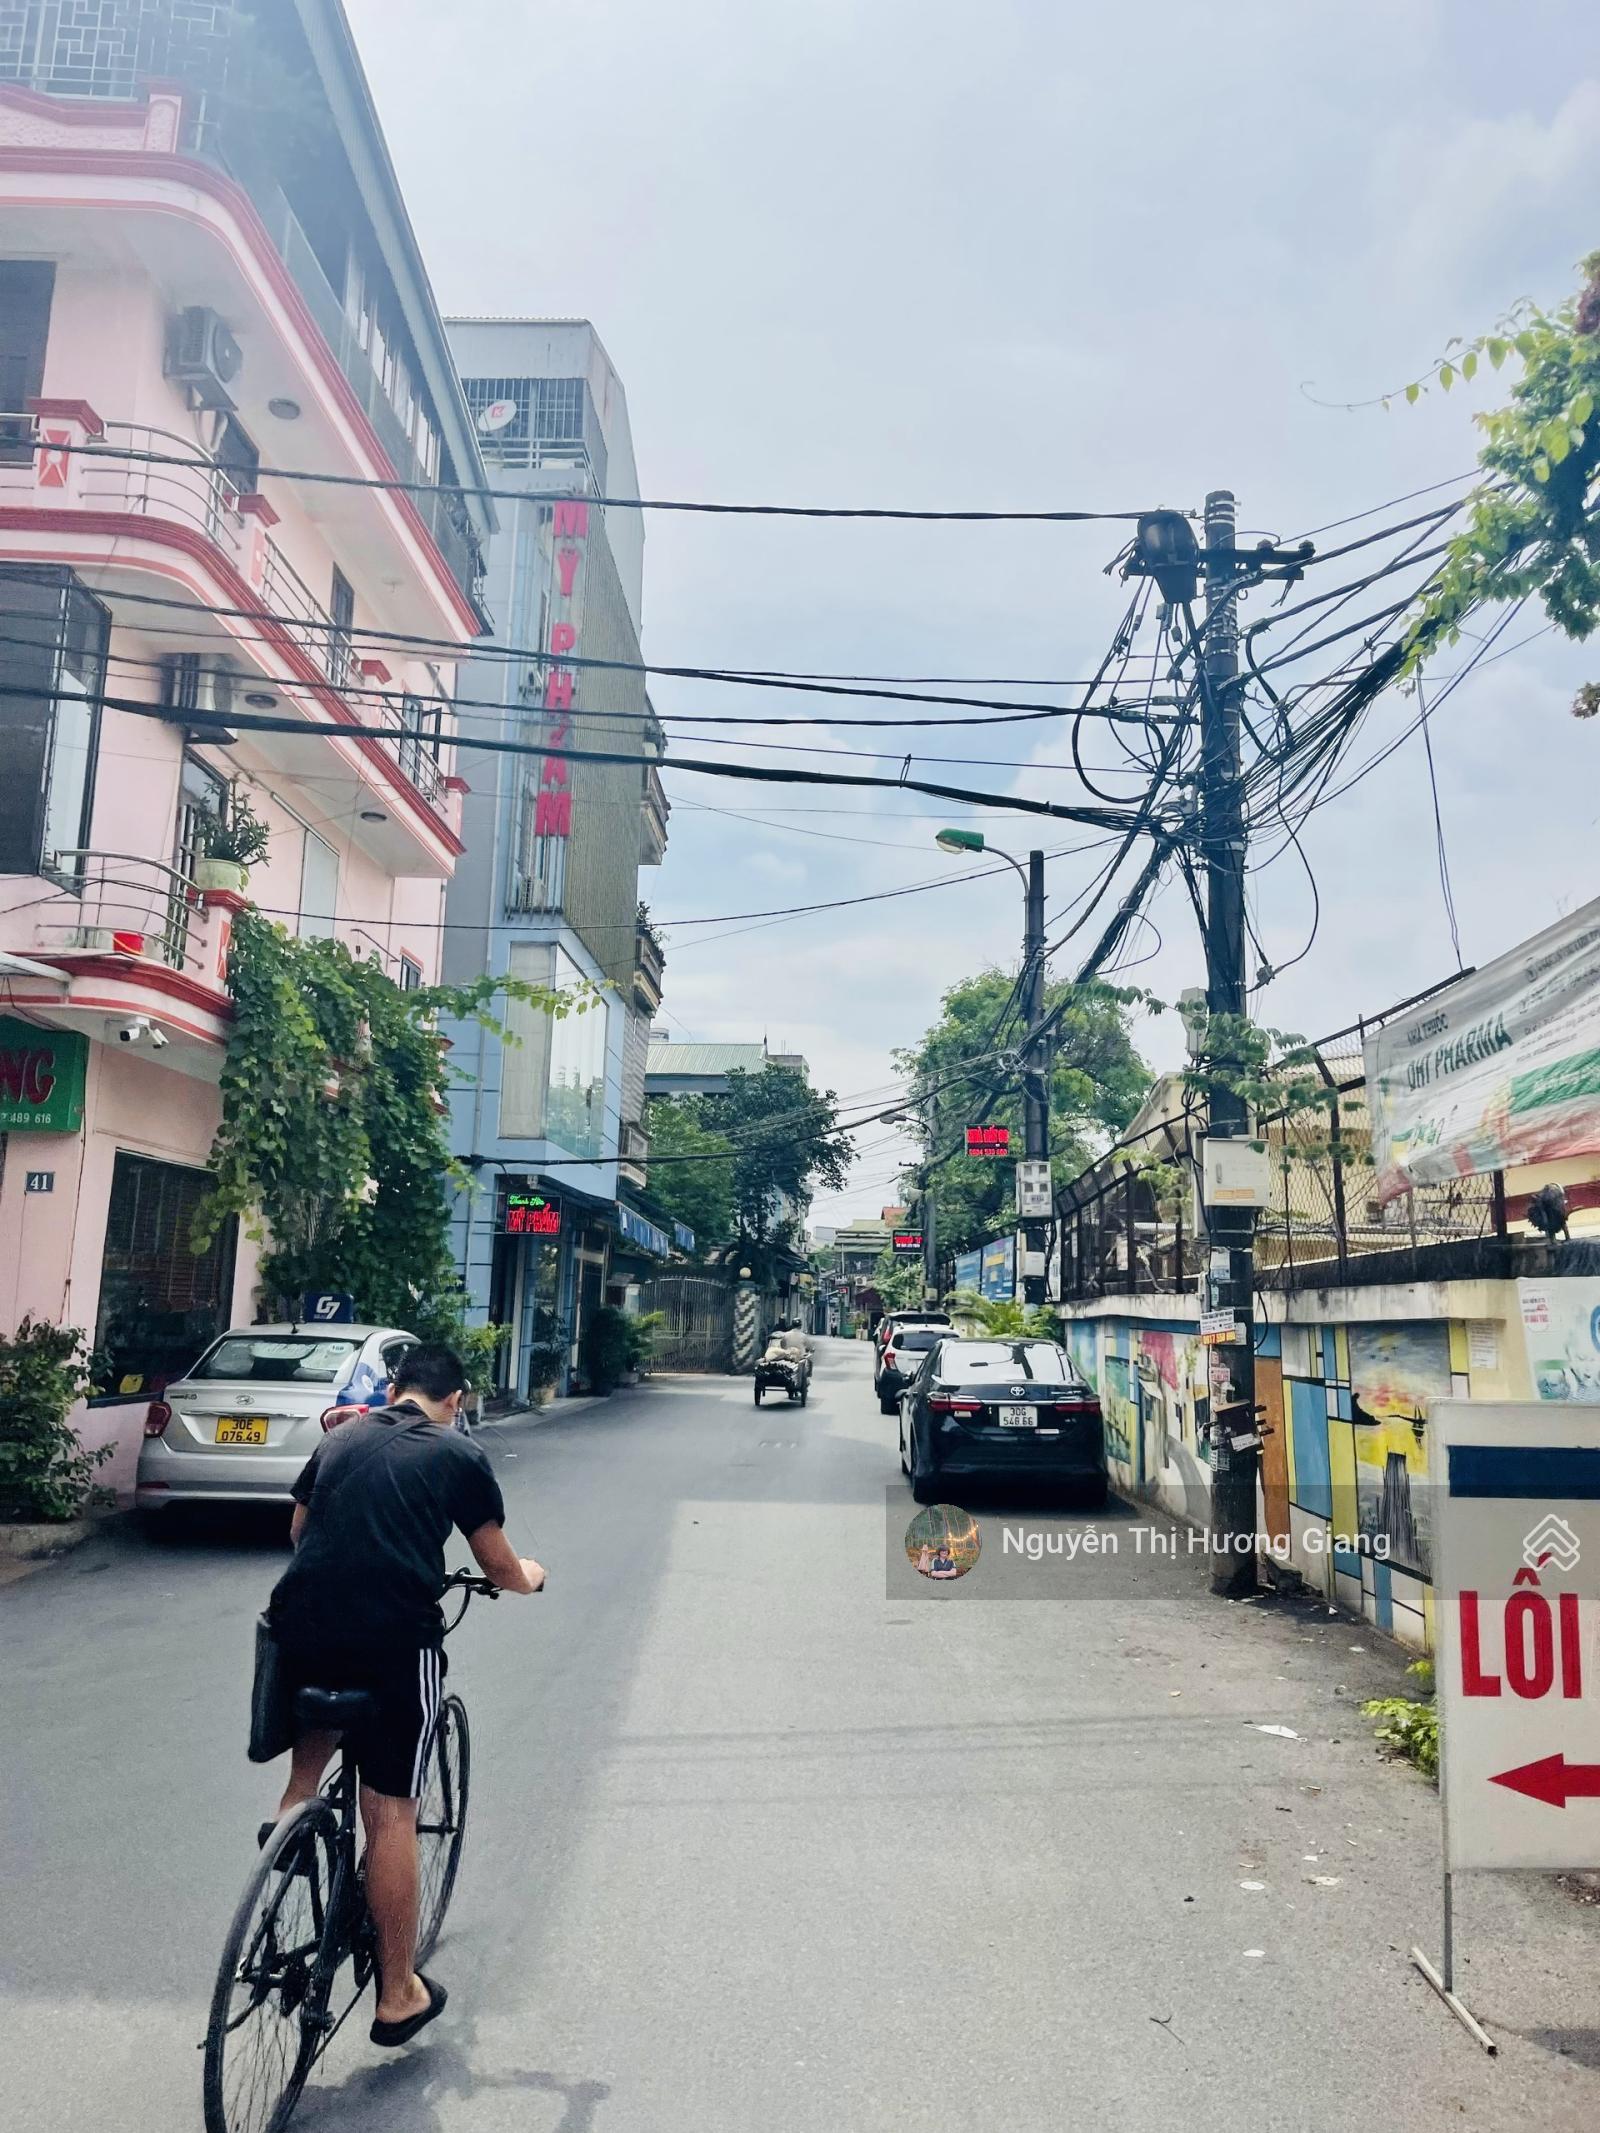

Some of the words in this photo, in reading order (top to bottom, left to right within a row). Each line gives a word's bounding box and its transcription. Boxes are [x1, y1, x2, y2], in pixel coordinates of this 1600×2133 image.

[1435, 1011, 1513, 1079] PHARMA
[34, 1113, 51, 1124] 616
[30, 1175, 48, 1190] 41
[316, 1296, 341, 1320] G7
[1010, 1407, 1026, 1416] 30G
[232, 1419, 254, 1430] 30E
[221, 1431, 261, 1442] 076.49
[1459, 1552, 1582, 1699] LỐI
